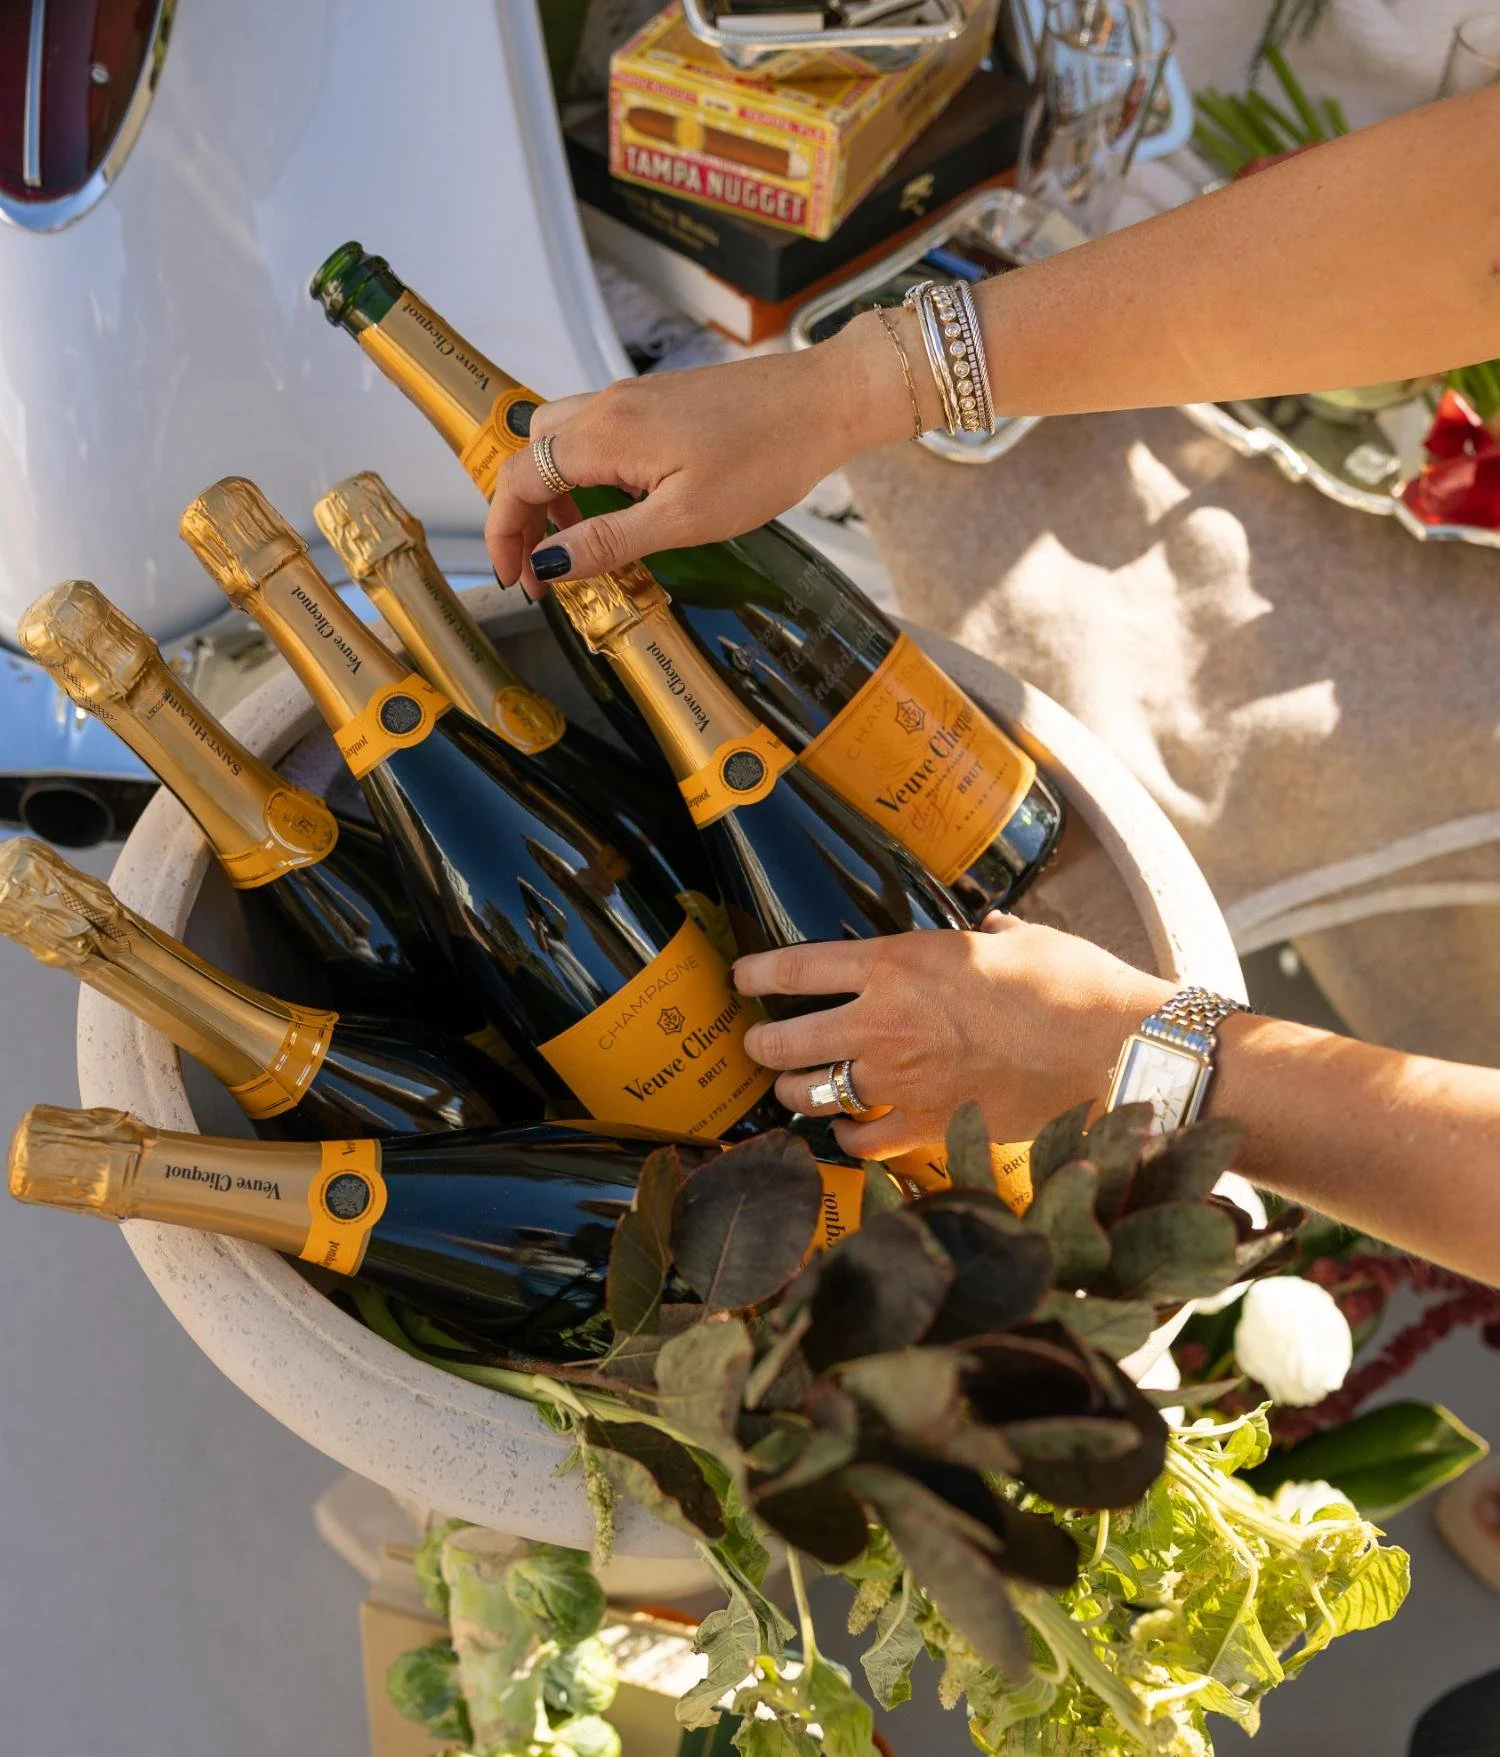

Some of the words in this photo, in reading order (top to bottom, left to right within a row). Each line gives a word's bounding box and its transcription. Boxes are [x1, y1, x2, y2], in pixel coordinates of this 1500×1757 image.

[626, 144, 702, 195] TAMPA
[706, 168, 807, 224] NUGGET
[402, 303, 455, 356] Clicquot
[455, 352, 490, 392] Veuve
[290, 585, 335, 639] Clicquot
[333, 636, 363, 675] Veuve
[645, 640, 686, 696] Clicquot
[161, 688, 242, 777] SAINT-HILAIRE
[684, 694, 711, 734] Veuve
[873, 759, 937, 814] Veuve
[956, 760, 984, 795] BRUT
[598, 954, 701, 1051] CHAMPAGNE
[623, 1057, 687, 1104] Veuve
[680, 997, 743, 1061] Clicquot
[697, 1056, 729, 1089] BRUT
[164, 1164, 232, 1192] Clicquot
[1001, 1150, 1029, 1176] BRU
[236, 1177, 282, 1200] Veuve
